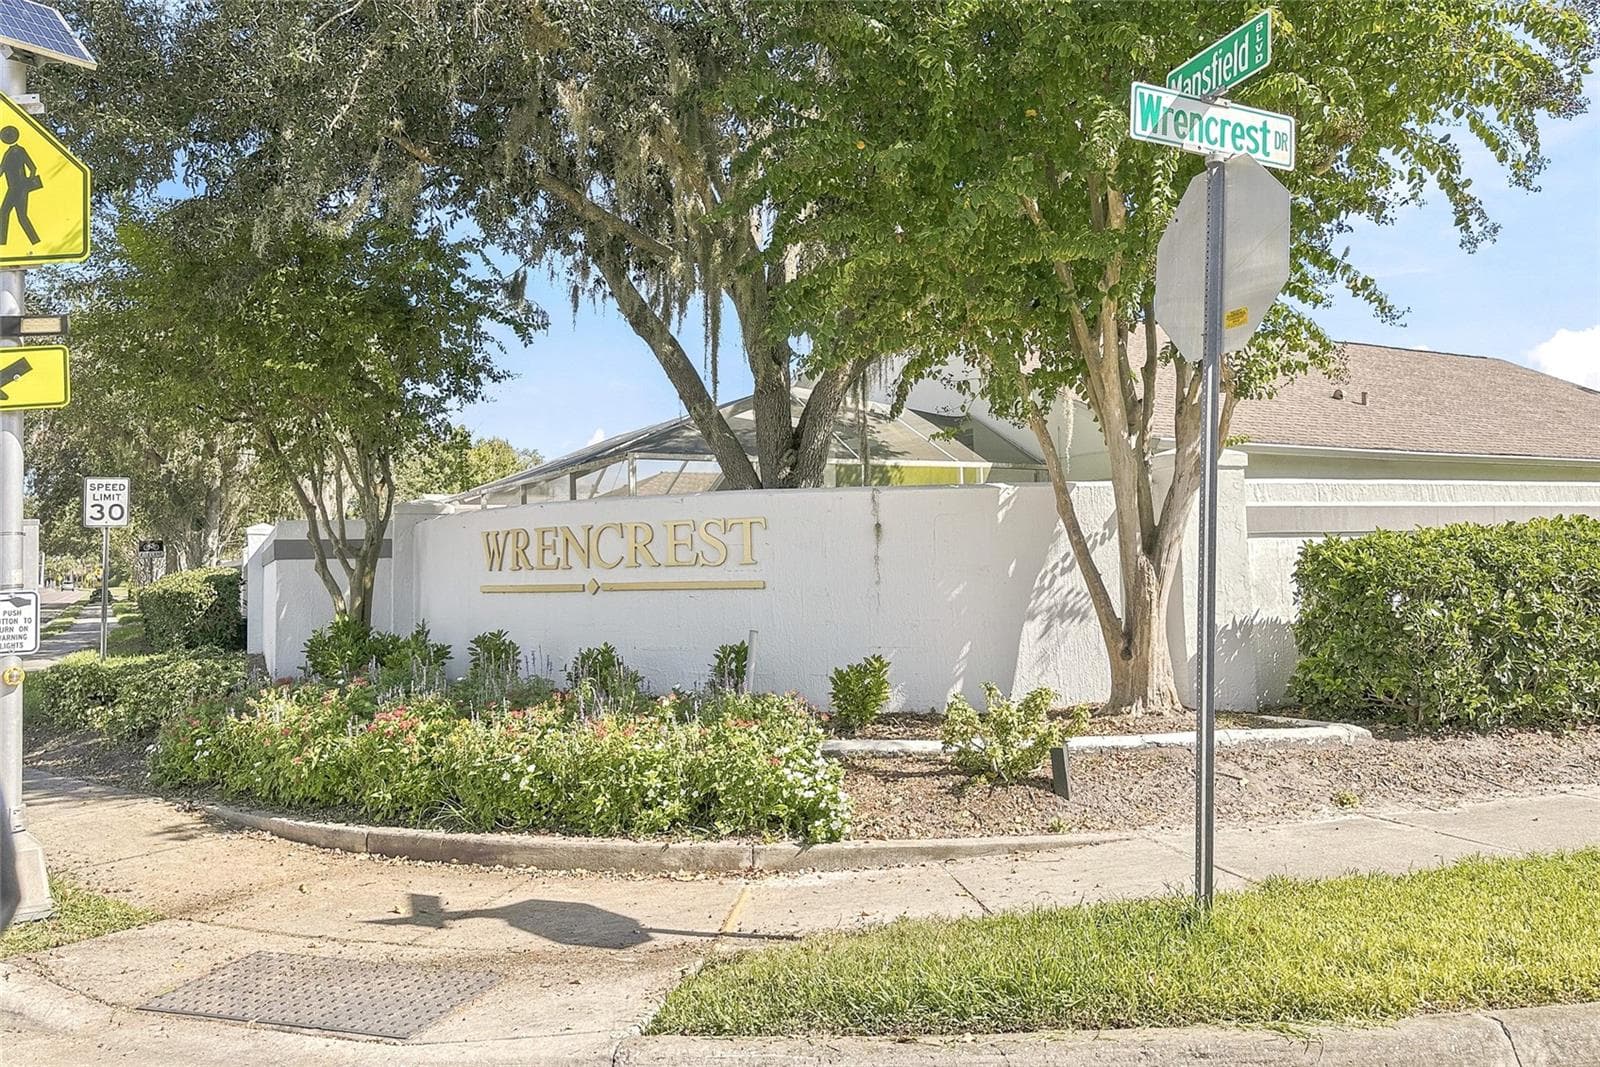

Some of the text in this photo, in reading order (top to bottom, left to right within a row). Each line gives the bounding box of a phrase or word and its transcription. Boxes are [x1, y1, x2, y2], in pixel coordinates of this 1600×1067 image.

[1255, 22, 1264, 64] BLVD
[1138, 91, 1289, 158] Wrencrest DR
[89, 483, 126, 491] SPEED
[92, 493, 122, 501] LIMIT
[89, 503, 125, 521] 30
[480, 516, 767, 571] WRENCREST
